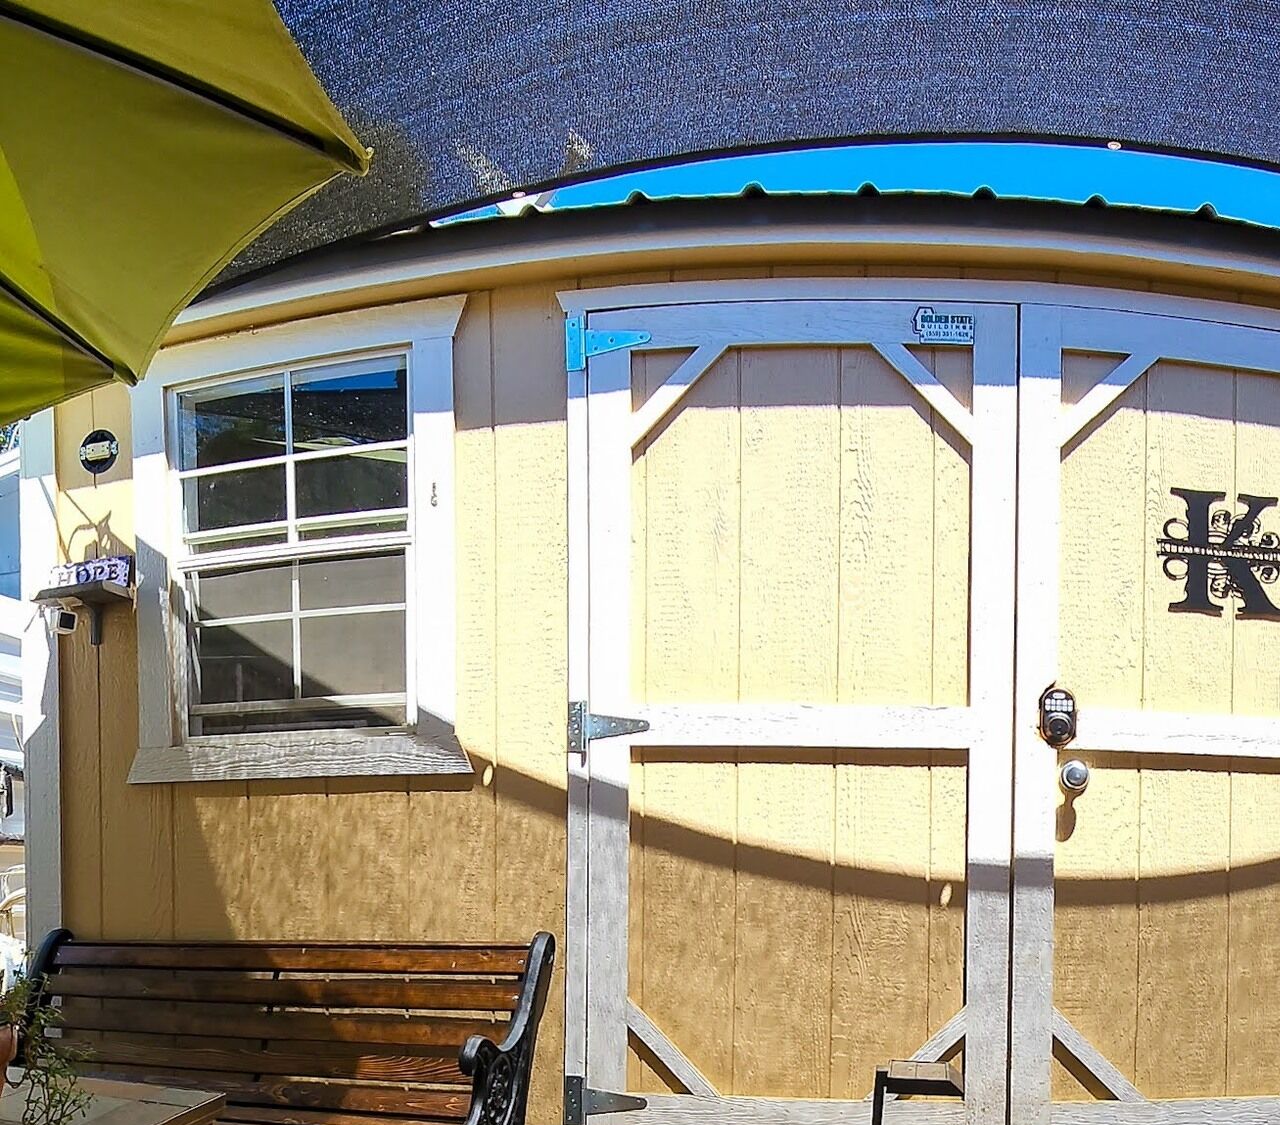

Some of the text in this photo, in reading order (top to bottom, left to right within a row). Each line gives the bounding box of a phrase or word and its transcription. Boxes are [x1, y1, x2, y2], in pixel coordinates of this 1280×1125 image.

[921, 315, 973, 324] GOLDEN STATE
[58, 564, 120, 586] HOPE
